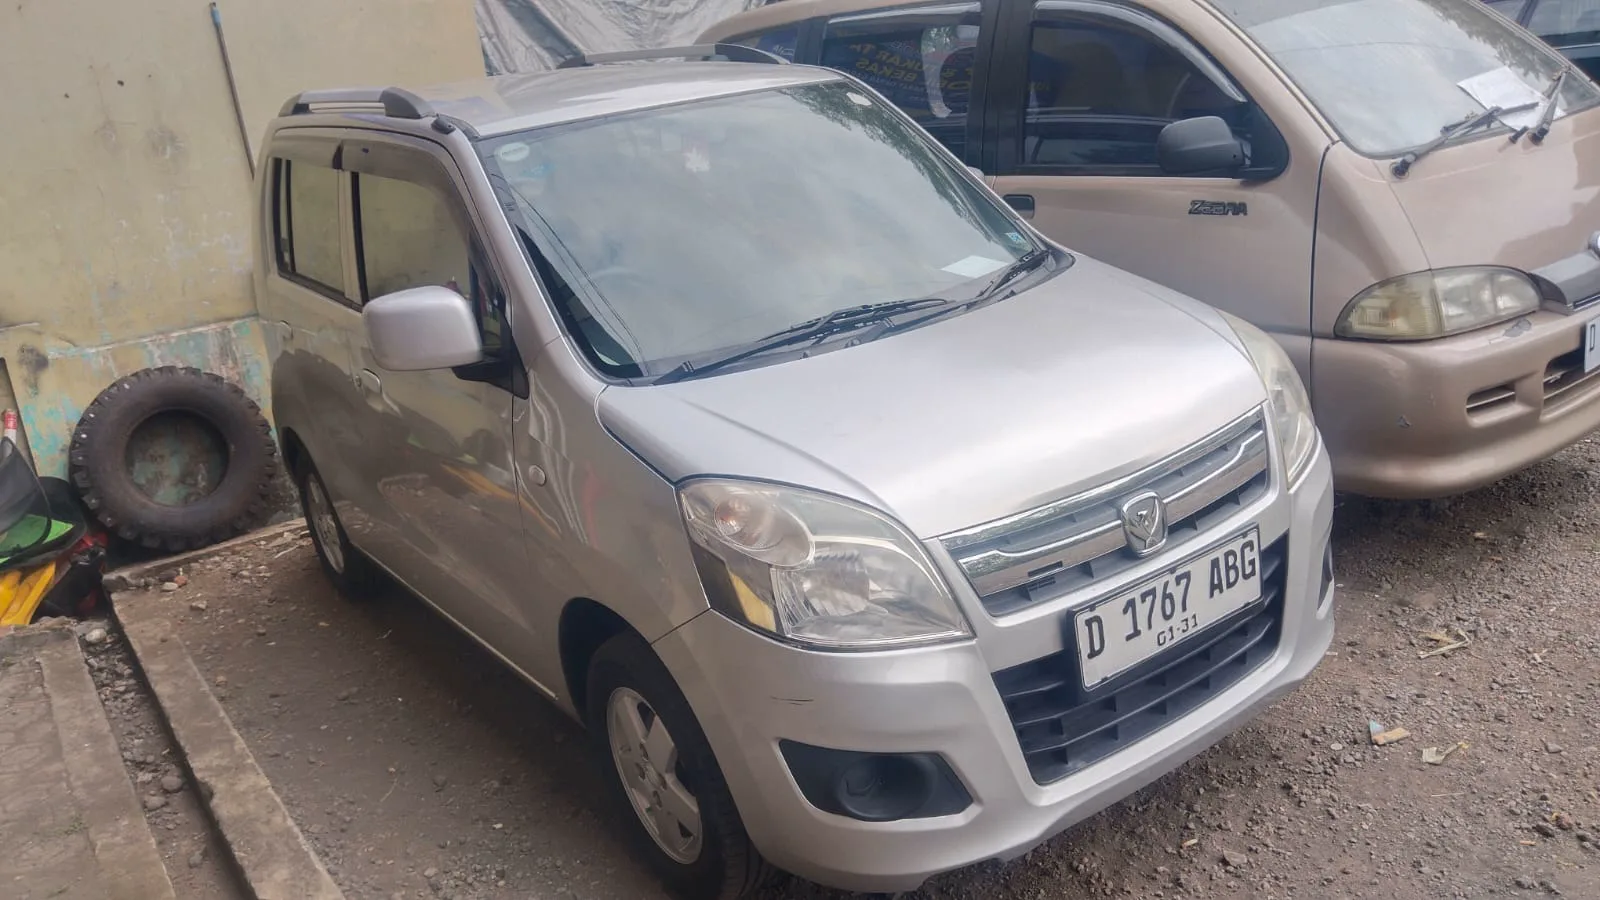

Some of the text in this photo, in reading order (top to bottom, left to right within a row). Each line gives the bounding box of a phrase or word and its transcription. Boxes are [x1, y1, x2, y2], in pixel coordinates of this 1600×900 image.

[1085, 539, 1257, 660] D 1767 ABG
